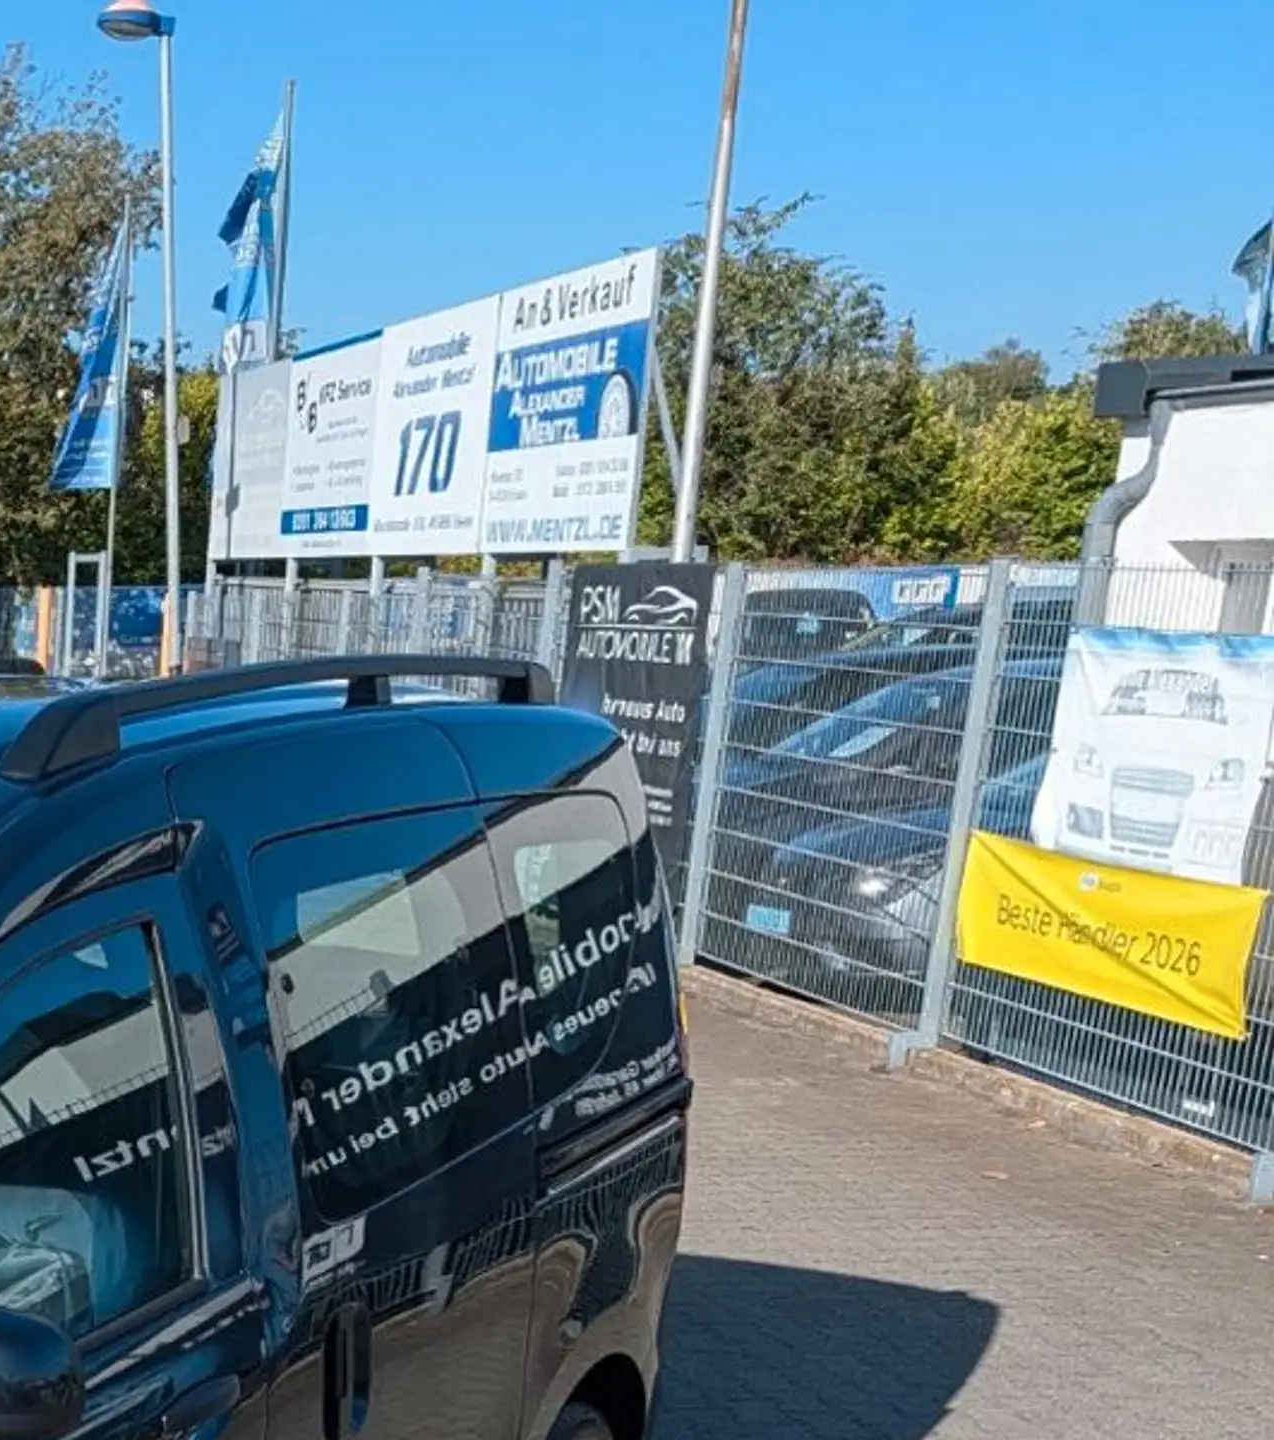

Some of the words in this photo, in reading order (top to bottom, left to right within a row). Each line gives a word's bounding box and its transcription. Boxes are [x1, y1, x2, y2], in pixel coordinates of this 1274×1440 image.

[514, 298, 538, 333] An
[540, 288, 552, 326] &
[558, 263, 638, 321] Verkauf
[495, 336, 619, 393] AUTOMOBILE
[337, 378, 373, 402] Service
[394, 410, 462, 496] 170
[518, 414, 581, 449] MENTZL
[576, 631, 672, 663] AUTOMOBILE
[655, 699, 686, 723] Auto
[997, 893, 1052, 937] Beste
[1140, 931, 1201, 976] 2026
